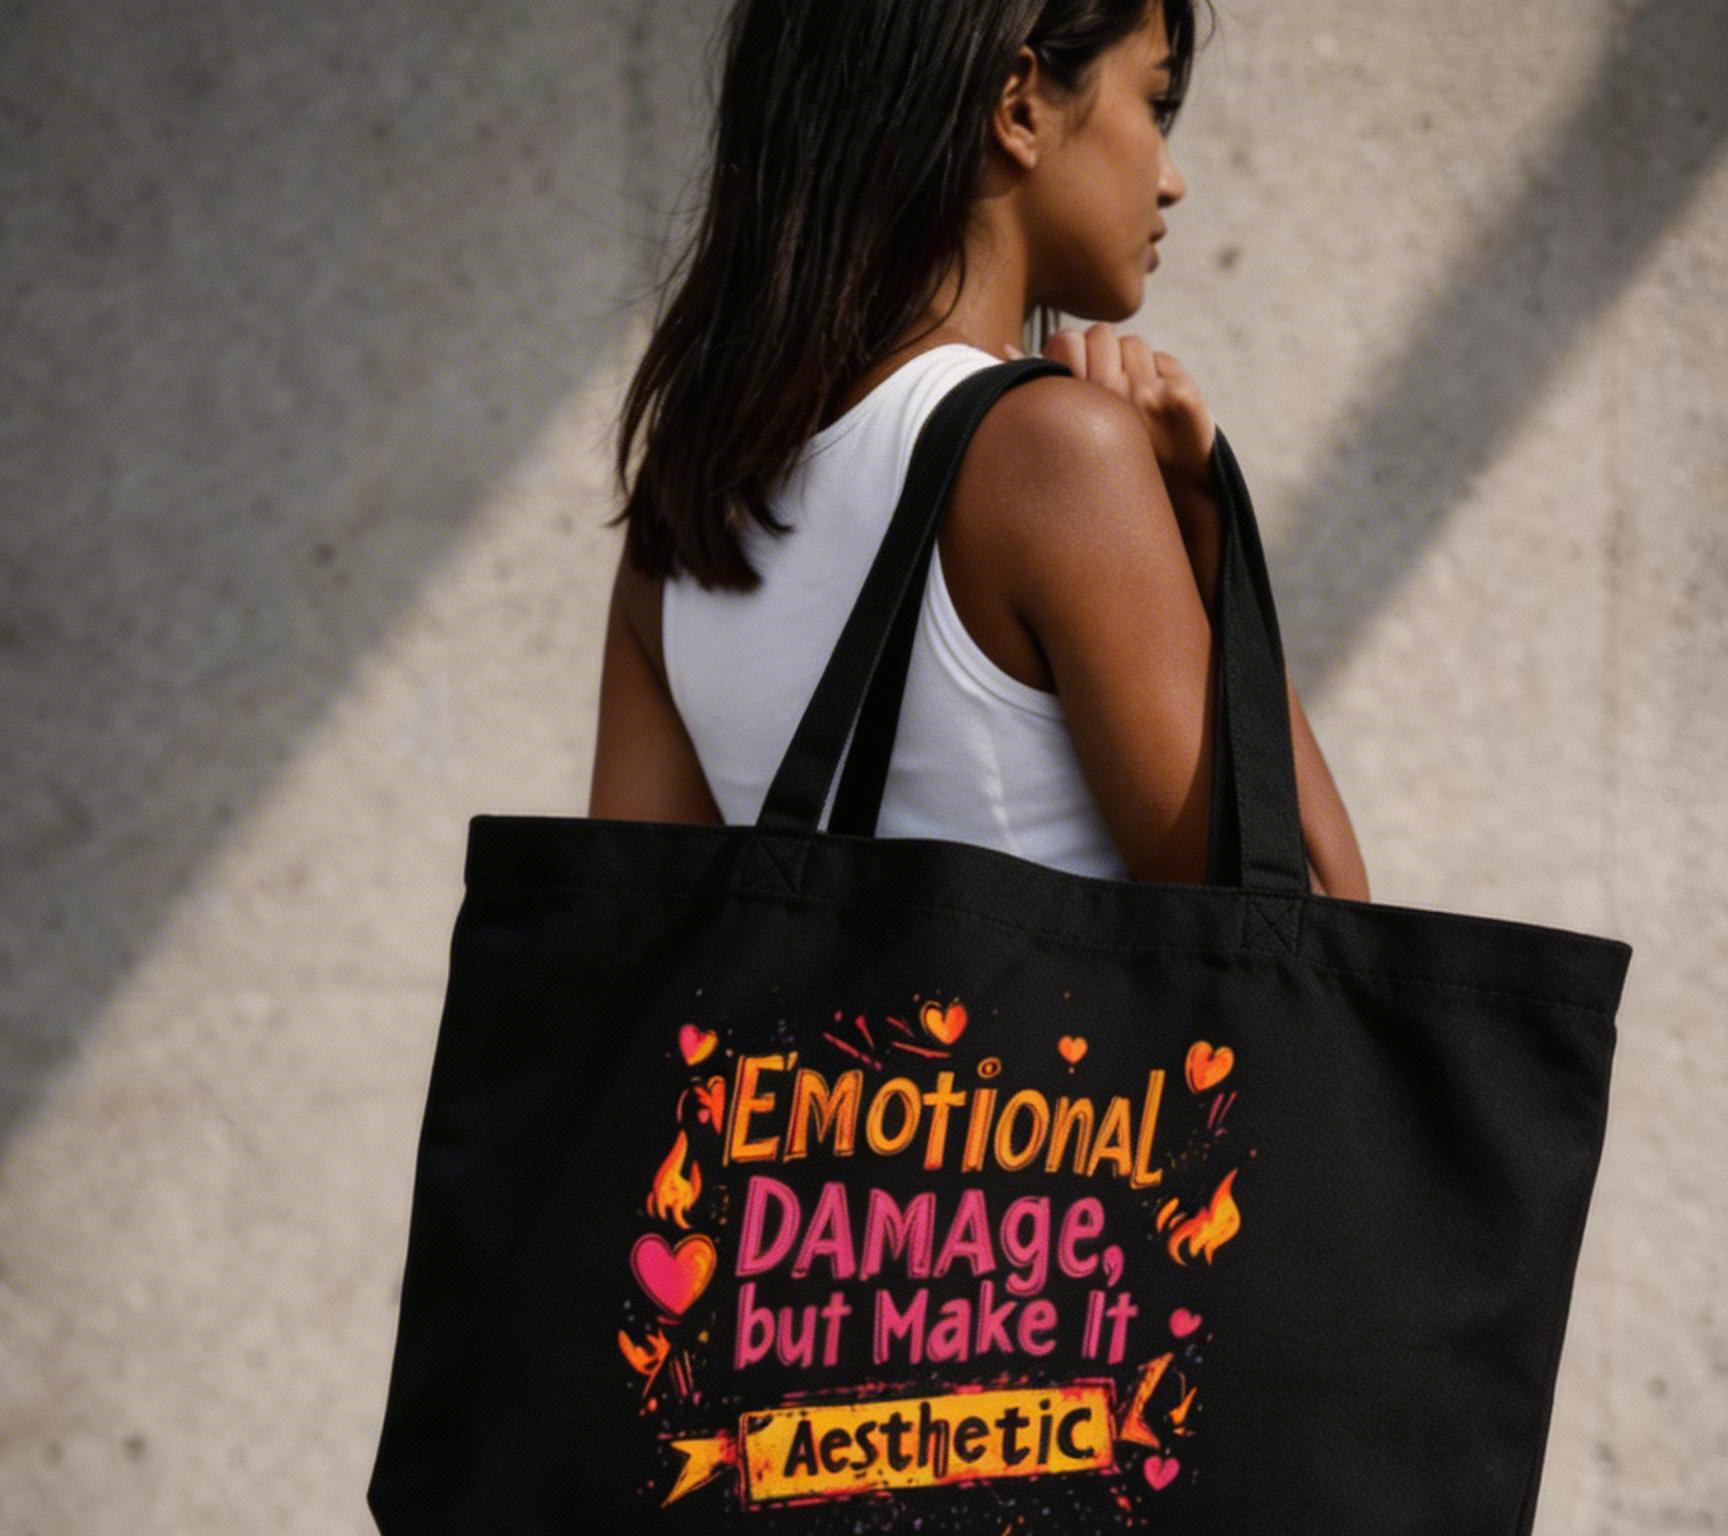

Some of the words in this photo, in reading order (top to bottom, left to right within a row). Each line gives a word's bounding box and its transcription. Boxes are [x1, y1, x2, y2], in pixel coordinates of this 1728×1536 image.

[734, 1282, 851, 1369] but
[872, 1280, 1057, 1365] Make
[1081, 1290, 1138, 1365] It
[783, 1400, 1096, 1478] Aesthetic
